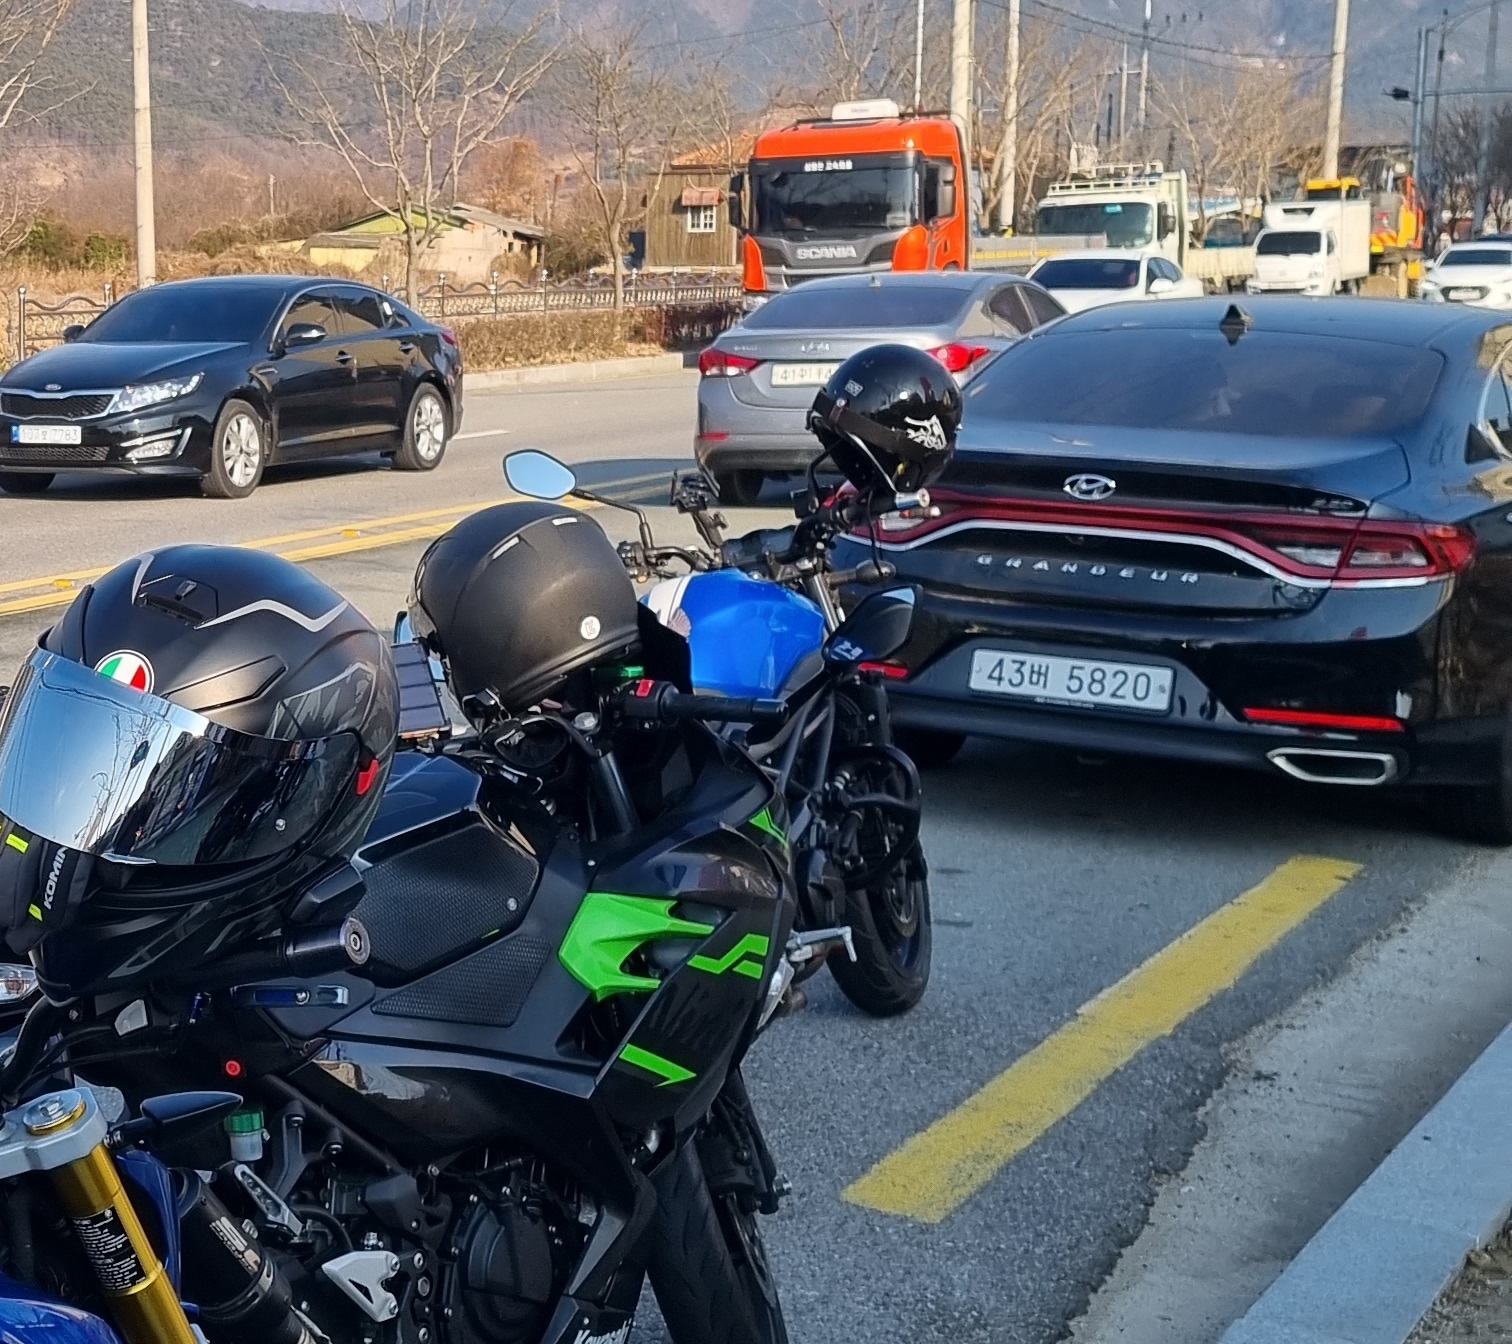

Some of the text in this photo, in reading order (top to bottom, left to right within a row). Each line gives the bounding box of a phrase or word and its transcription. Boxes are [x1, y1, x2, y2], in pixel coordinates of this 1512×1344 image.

[796, 245, 857, 260] SCANIA
[51, 428, 78, 442] 7783
[976, 554, 1199, 583] GRANDEUR
[987, 657, 1152, 702] 43버 5820
